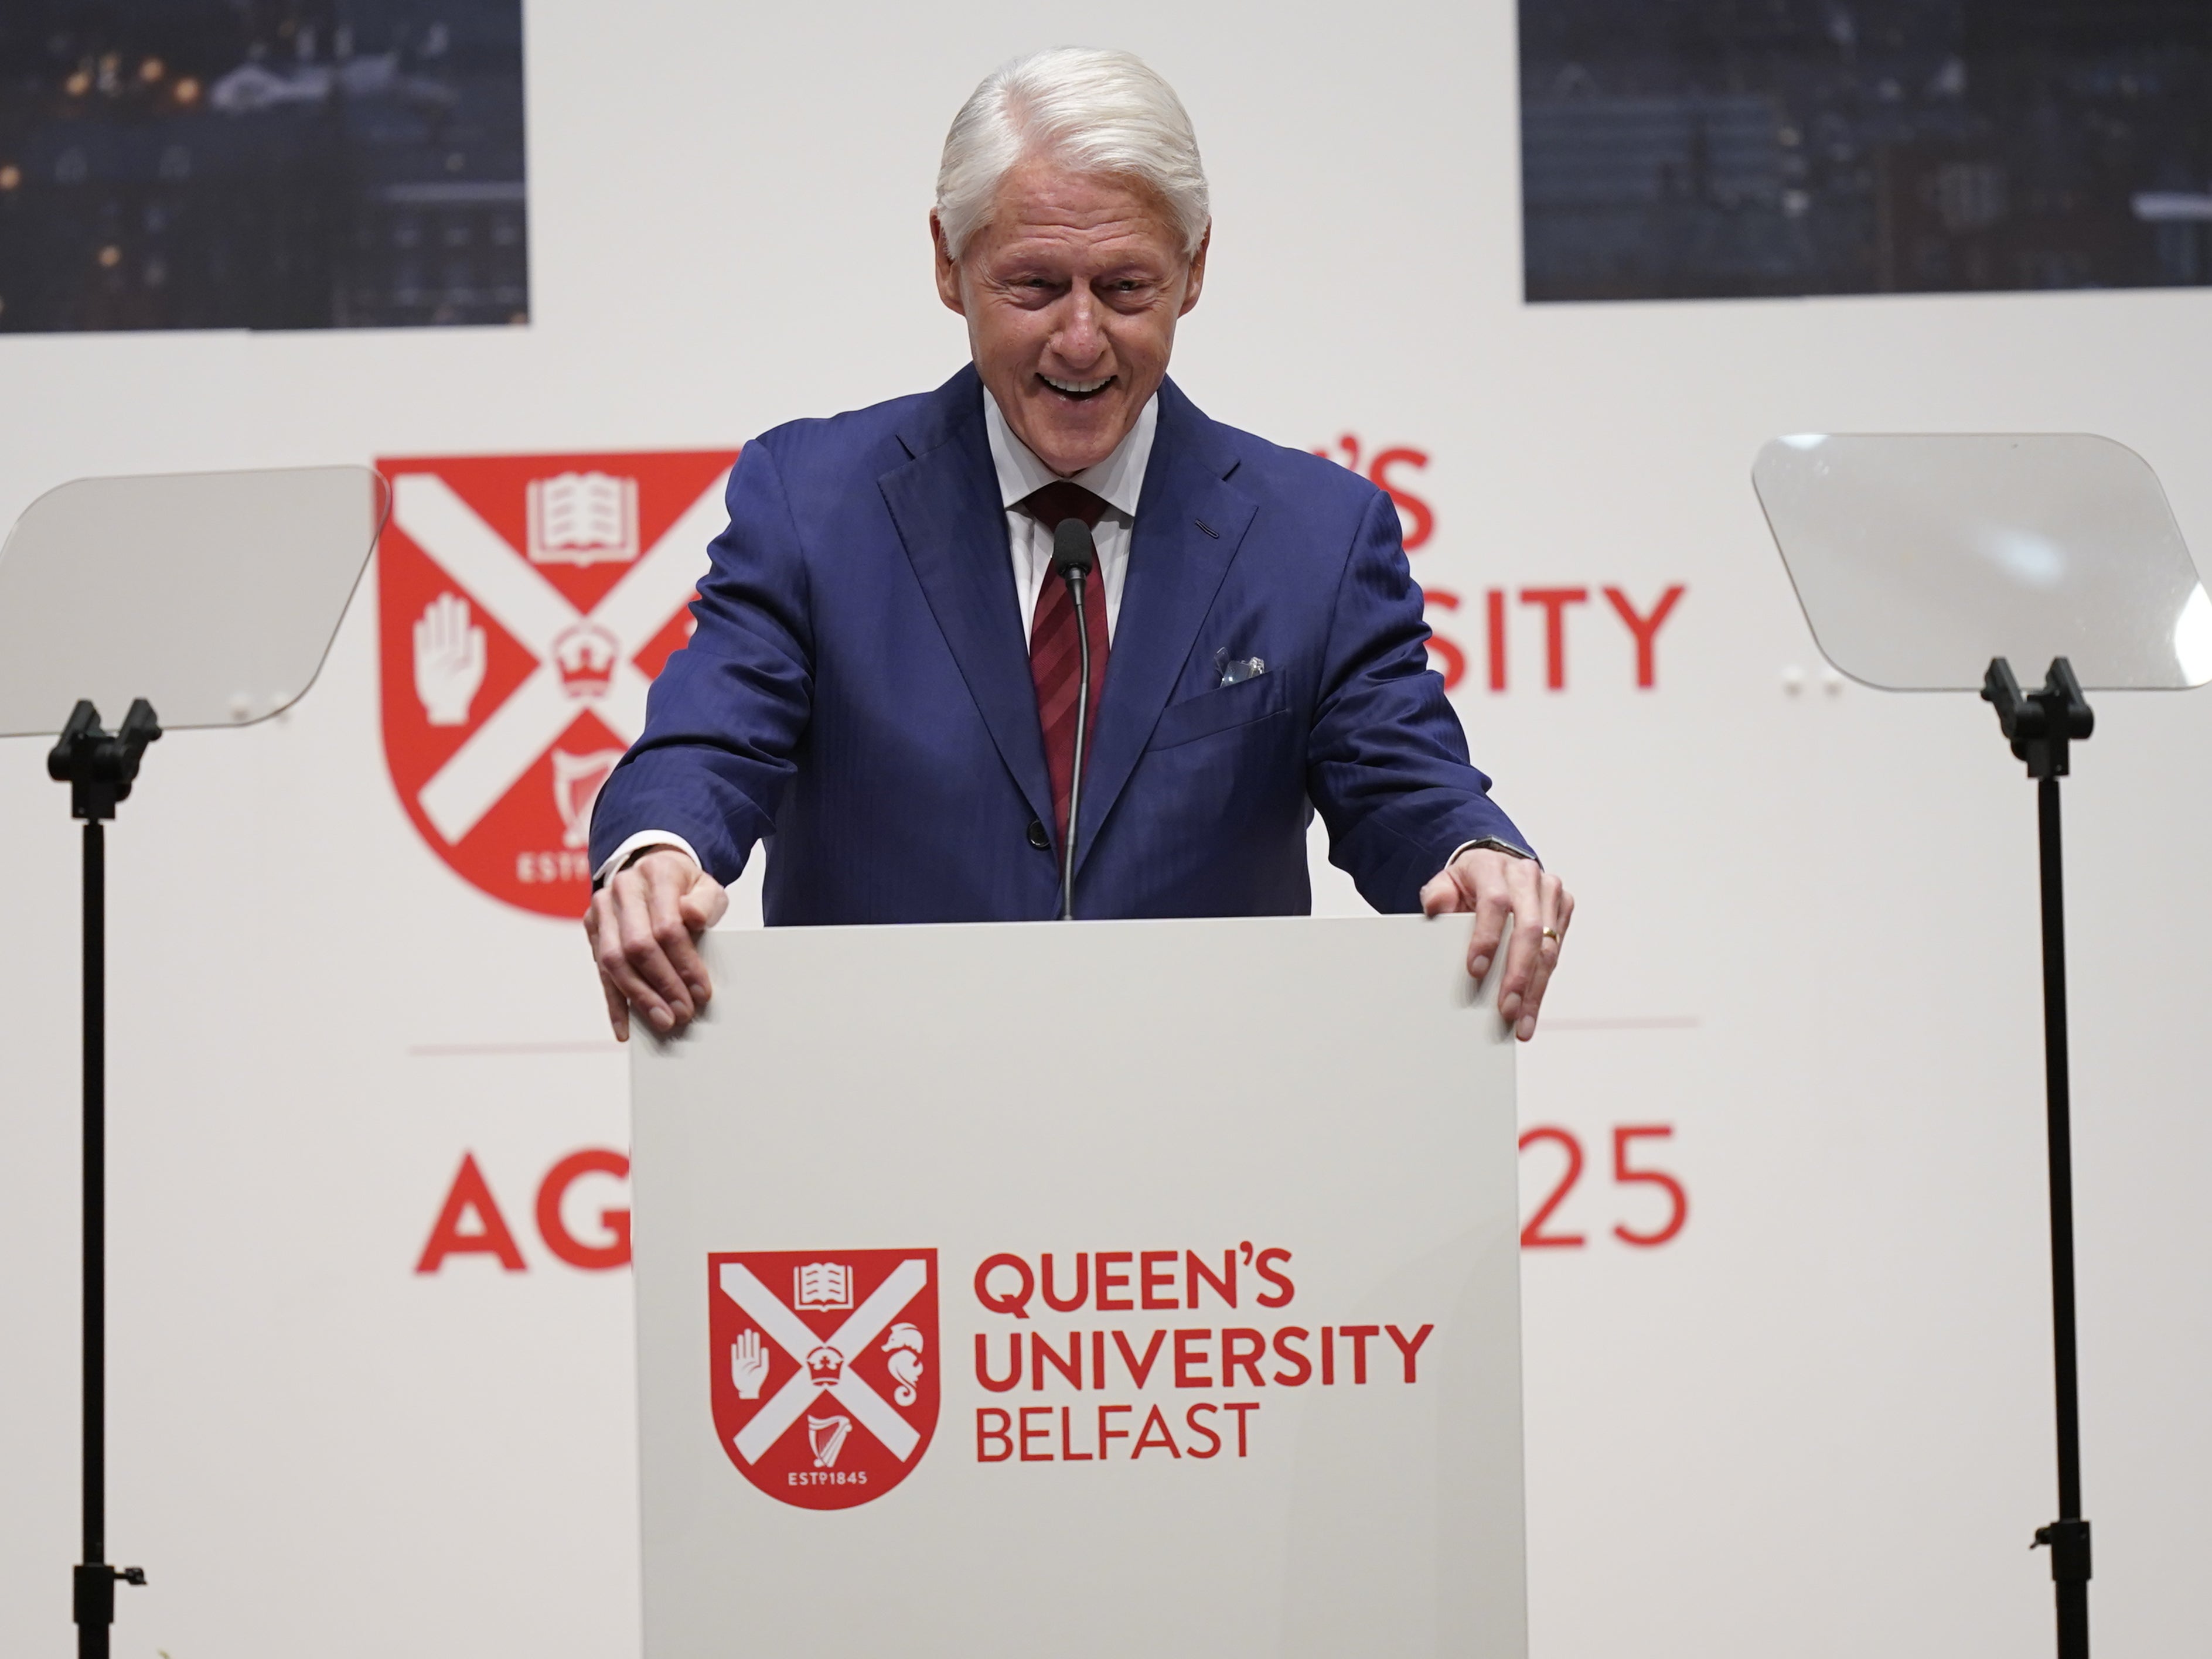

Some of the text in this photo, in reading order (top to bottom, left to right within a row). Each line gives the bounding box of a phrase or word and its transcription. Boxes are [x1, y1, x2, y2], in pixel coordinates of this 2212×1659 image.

[415, 1125, 1688, 1274] AG 25
[974, 1241, 1295, 1319] QUEEN'S
[974, 1324, 1434, 1392] UNIVERSITY
[976, 1402, 1260, 1463] BELFAST
